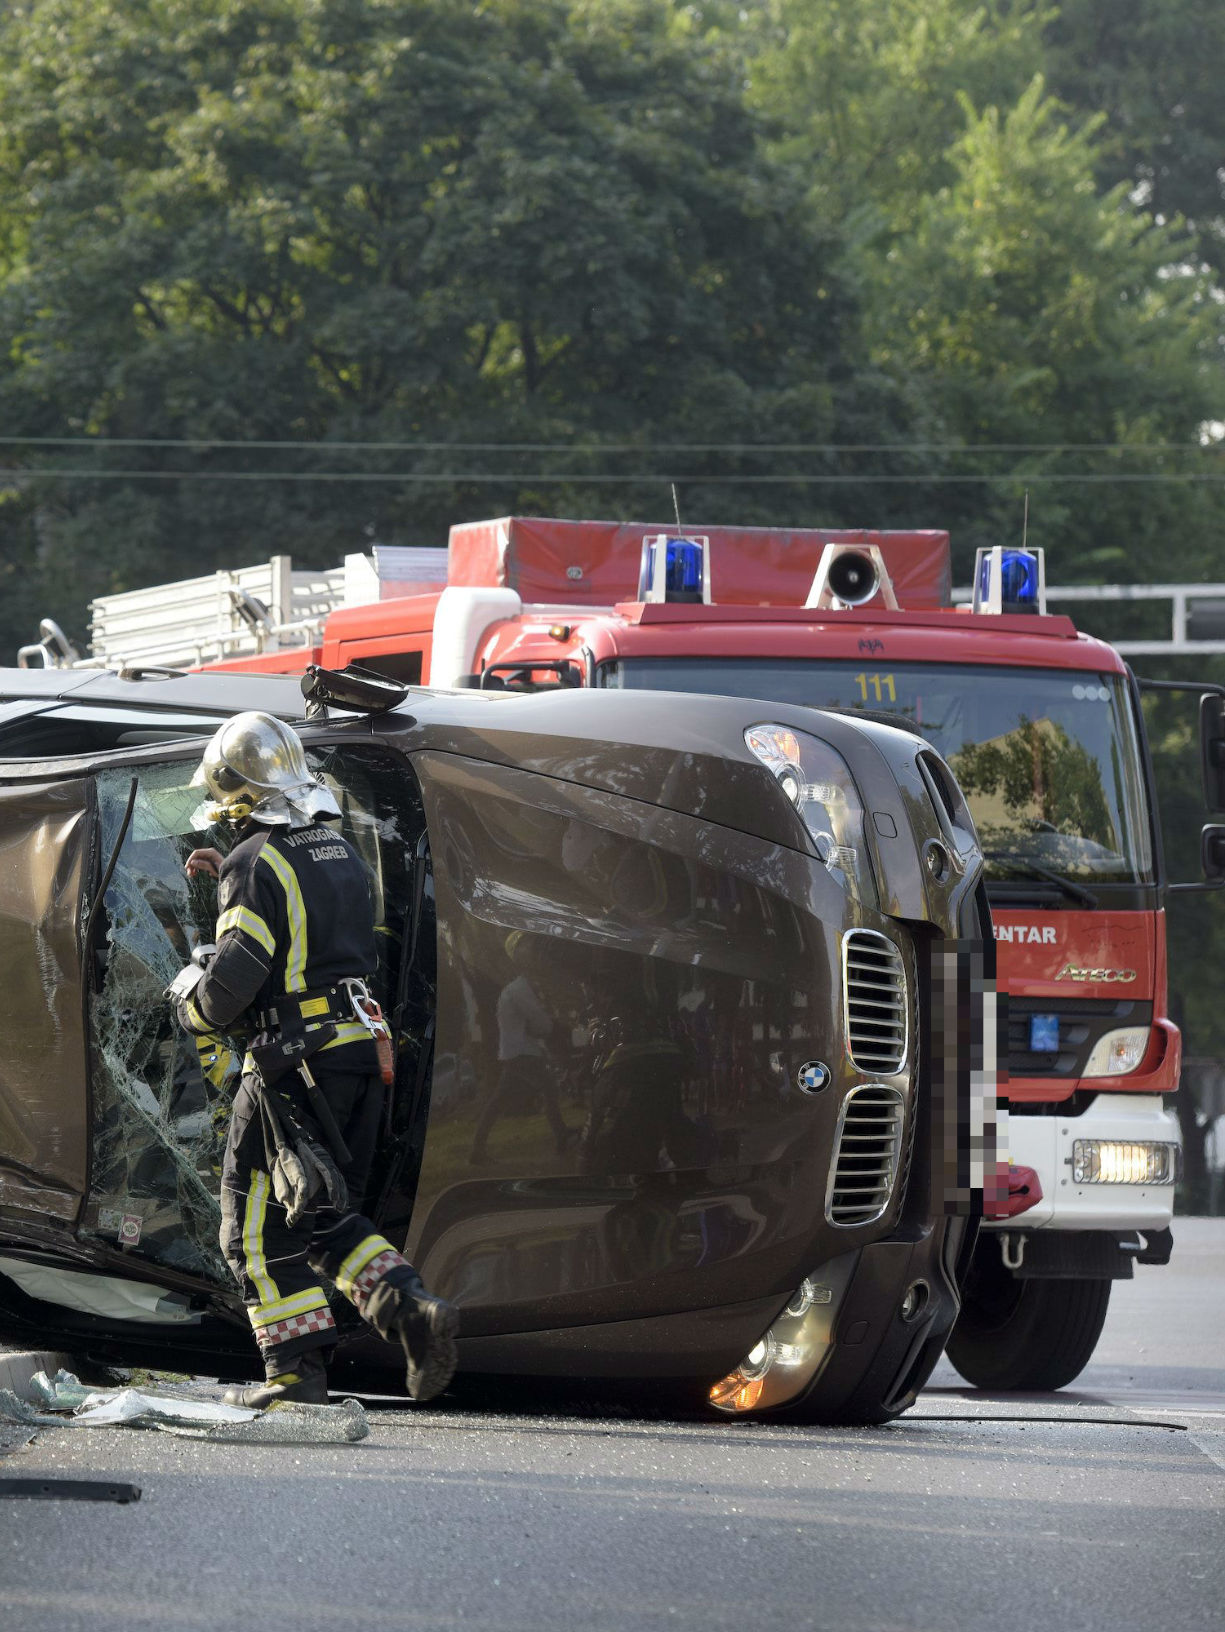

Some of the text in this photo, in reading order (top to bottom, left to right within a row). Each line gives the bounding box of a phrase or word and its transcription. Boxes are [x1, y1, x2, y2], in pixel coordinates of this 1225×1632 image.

[855, 672, 896, 702] 111
[282, 828, 346, 848] VATROGAS
[308, 845, 349, 862] ZAGREB
